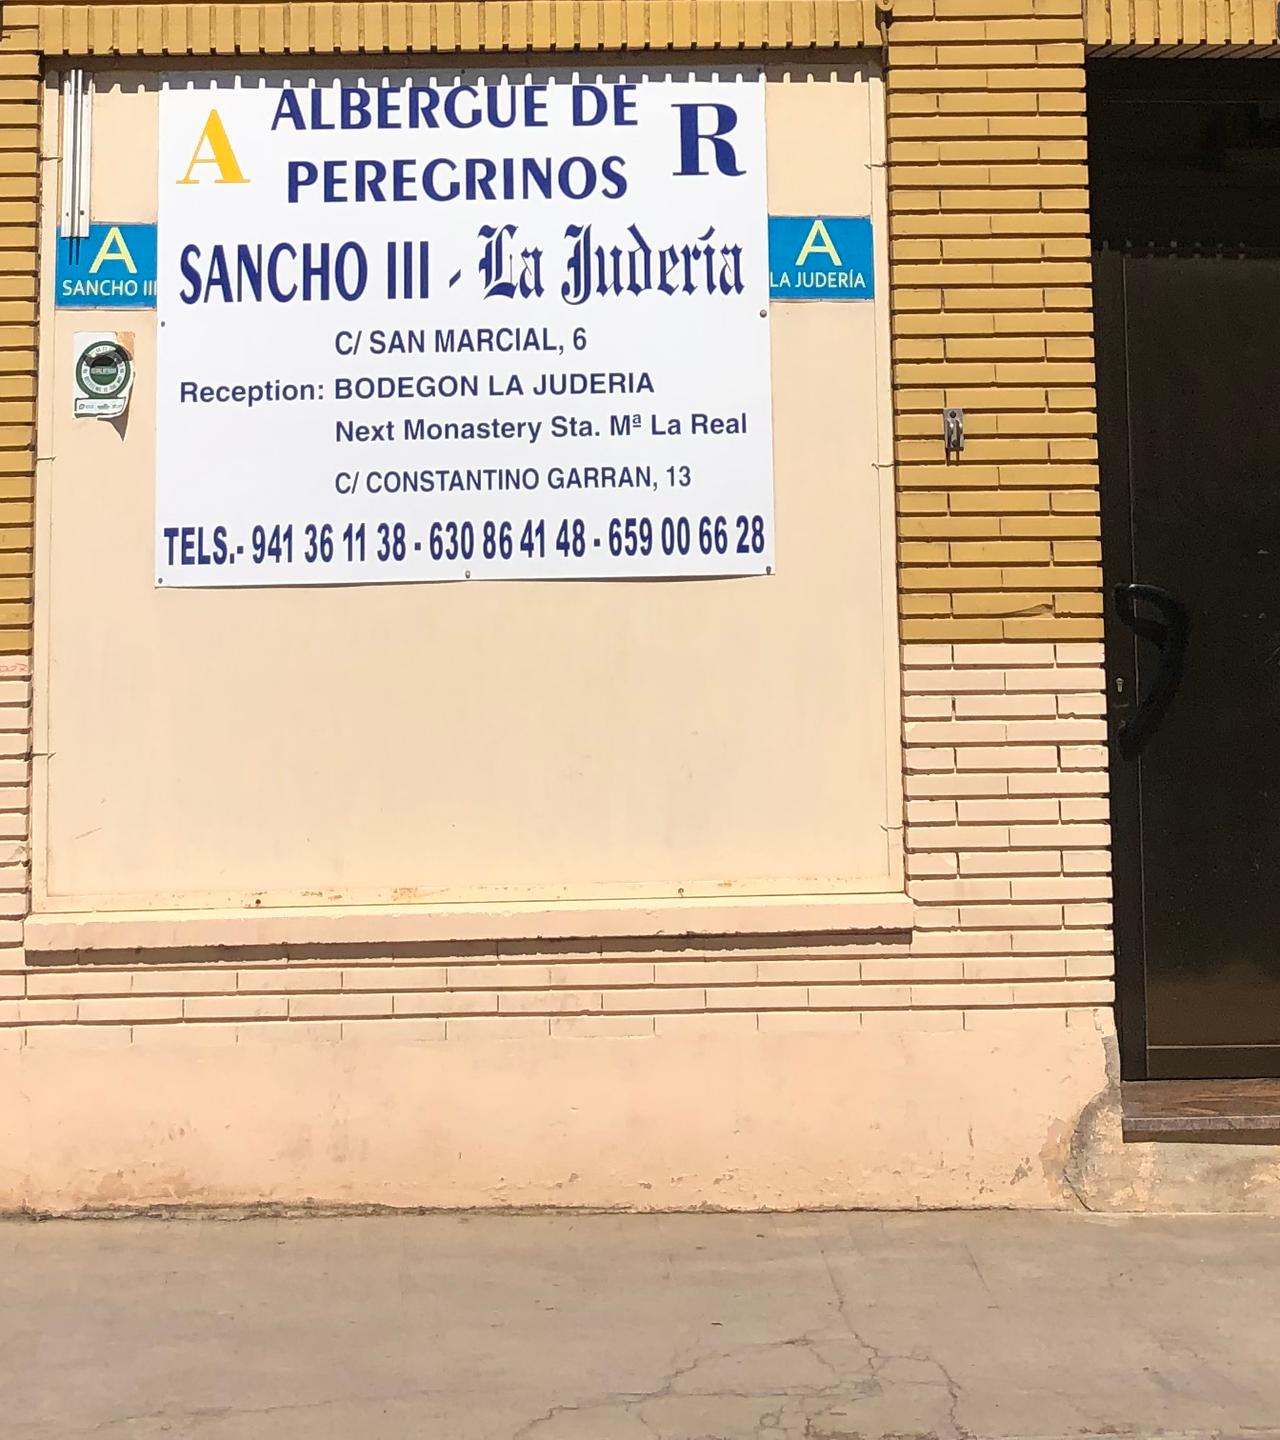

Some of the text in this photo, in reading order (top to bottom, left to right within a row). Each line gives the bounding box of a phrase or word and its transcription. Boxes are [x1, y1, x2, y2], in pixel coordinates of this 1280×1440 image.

[271, 84, 638, 131] ALBERGUE DE
[176, 108, 251, 185] A
[671, 103, 747, 177] R
[287, 155, 628, 203] PEREGRINOS
[88, 226, 138, 274] A
[179, 240, 368, 305] SANCHO
[387, 241, 429, 300] III
[477, 223, 545, 299] La
[561, 223, 745, 305] Judería
[794, 219, 843, 267] A
[62, 279, 157, 296] SANCHO III
[770, 268, 867, 288] LA JUDERÍA
[334, 327, 587, 356] C/ SAN MARCIAL, 6
[180, 372, 655, 407] Reception: BODEGON LA JUDERIA
[335, 420, 395, 443] Next
[404, 417, 542, 444] Monastery
[551, 415, 601, 438] Sta.
[651, 414, 682, 436] La
[691, 413, 748, 435] Real
[334, 466, 692, 495] C/ CONSTANTINO GARRAN, 13
[252, 524, 294, 564] 941
[304, 523, 334, 563] 36
[343, 523, 366, 562] 11
[377, 522, 406, 562] 38
[429, 521, 474, 561] 630
[482, 520, 513, 560] 86
[520, 519, 545, 558] 41
[556, 518, 586, 558] 48
[608, 517, 653, 557] 659
[661, 516, 691, 556] 00
[698, 516, 728, 555] 66
[736, 515, 765, 554] 28
